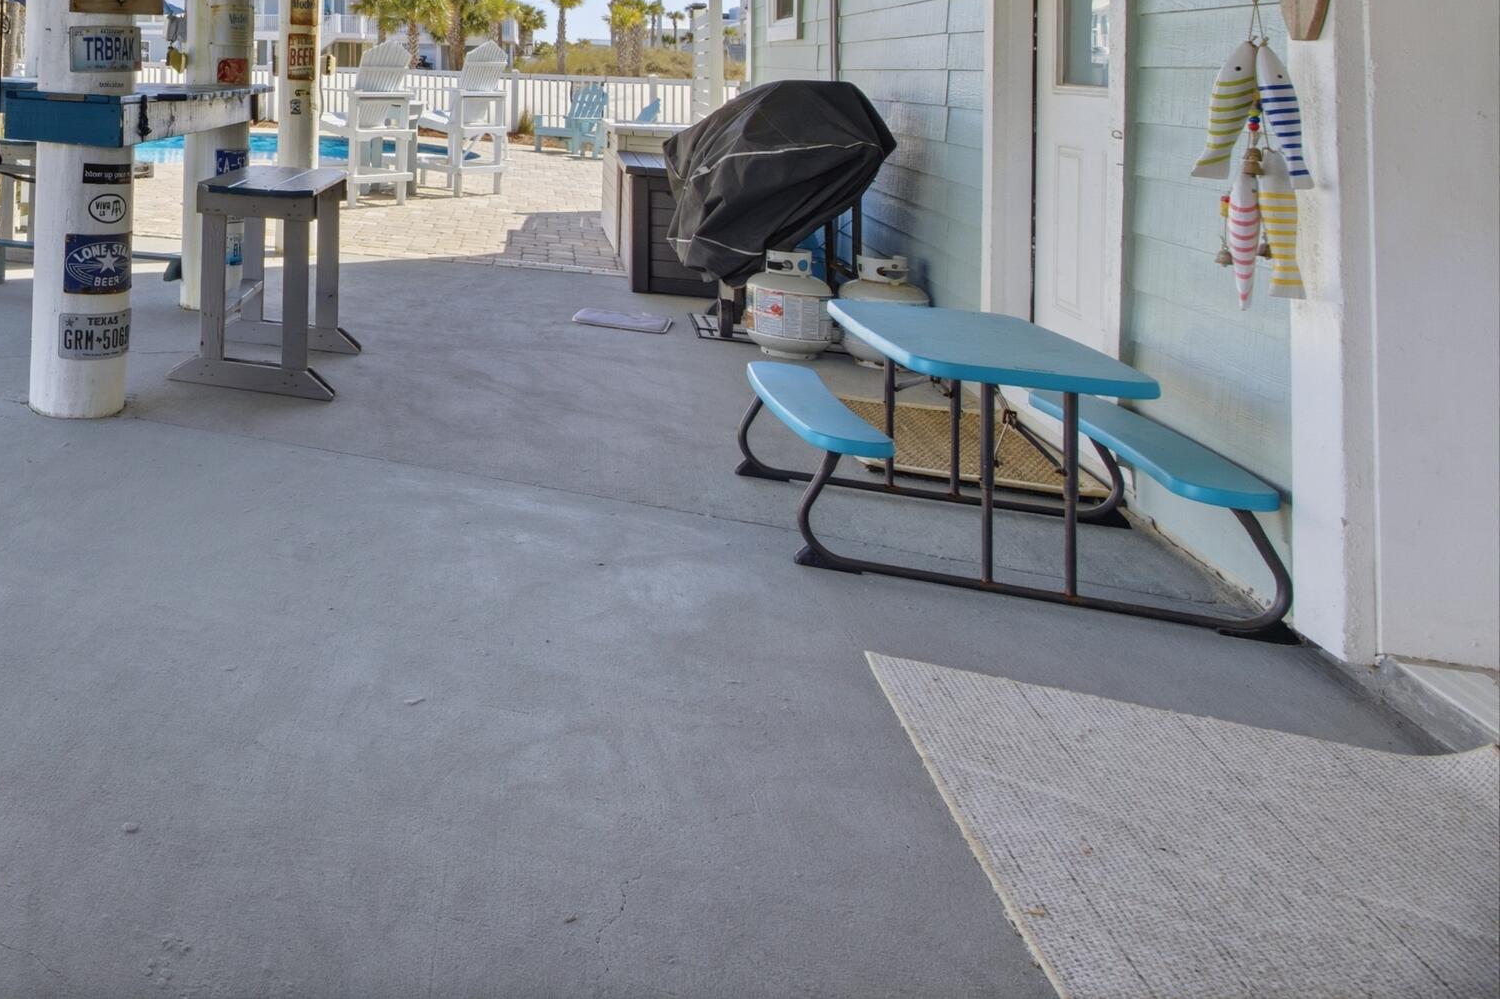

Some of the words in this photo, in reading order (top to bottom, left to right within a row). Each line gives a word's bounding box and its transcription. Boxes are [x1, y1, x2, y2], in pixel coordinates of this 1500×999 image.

[289, 48, 315, 67] BEER
[73, 244, 108, 263] LONE
[93, 275, 120, 287] BEER
[87, 315, 119, 327] TEXAS
[63, 328, 95, 351] GRM
